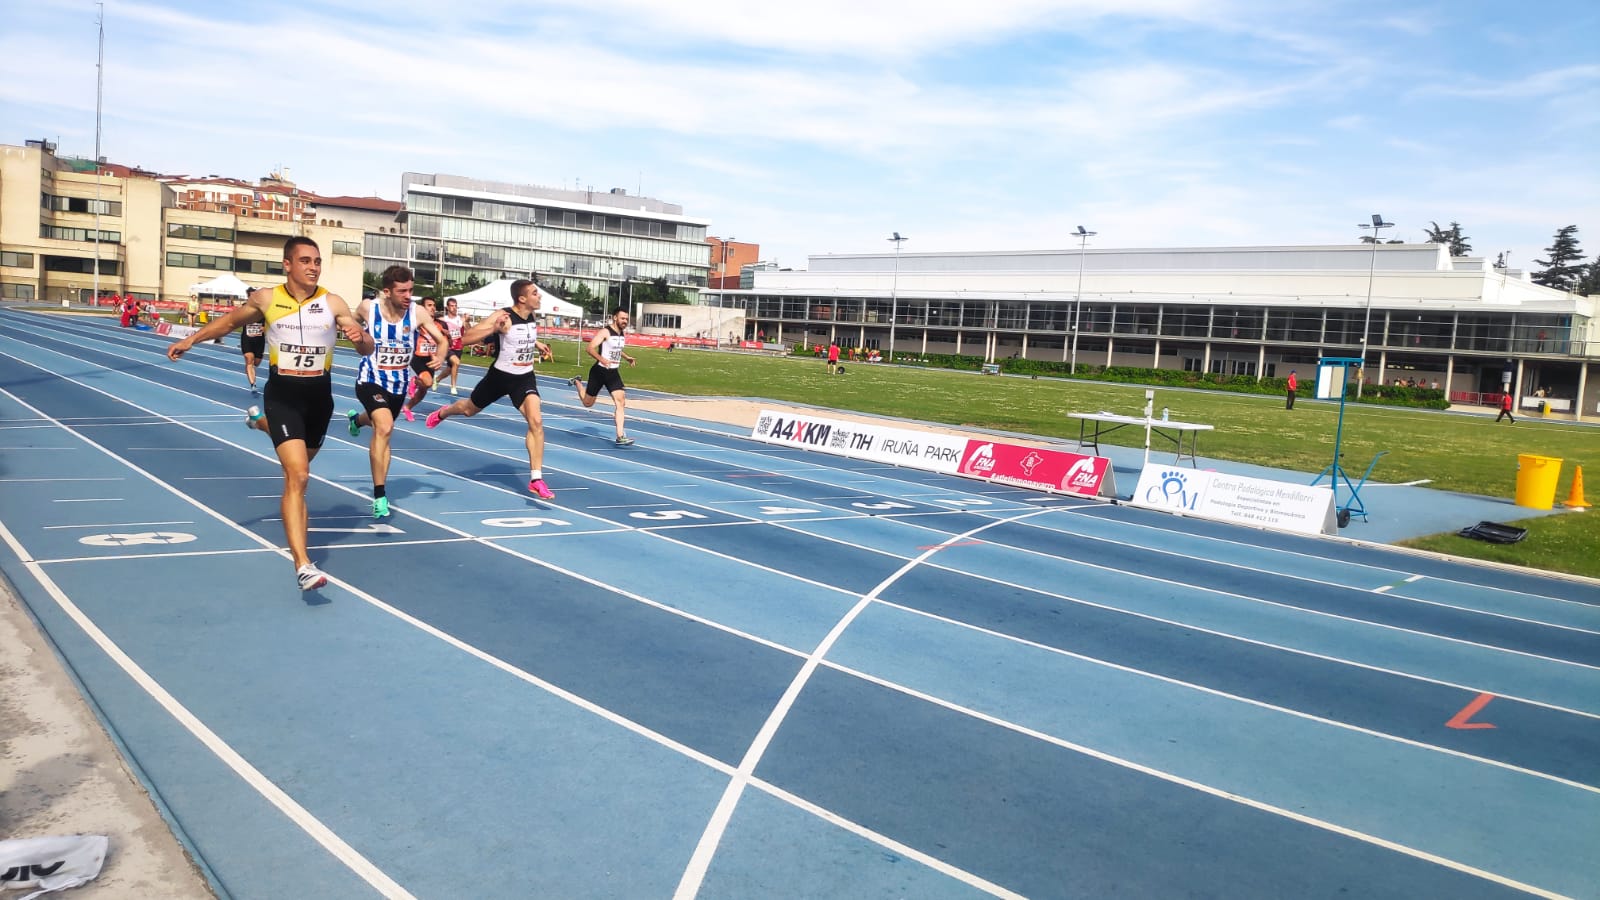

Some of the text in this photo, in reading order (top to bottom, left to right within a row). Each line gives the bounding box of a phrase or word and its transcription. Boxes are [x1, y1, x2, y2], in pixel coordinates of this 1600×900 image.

[294, 355, 315, 368] 15
[380, 355, 410, 365] 2134
[770, 418, 832, 446] A4XKM
[881, 439, 961, 463] IRUÑA PARK
[975, 457, 996, 468] FNA
[1074, 473, 1098, 485] FNA
[629, 510, 708, 520] 5
[481, 517, 572, 528] 6
[78, 531, 198, 546] 8
